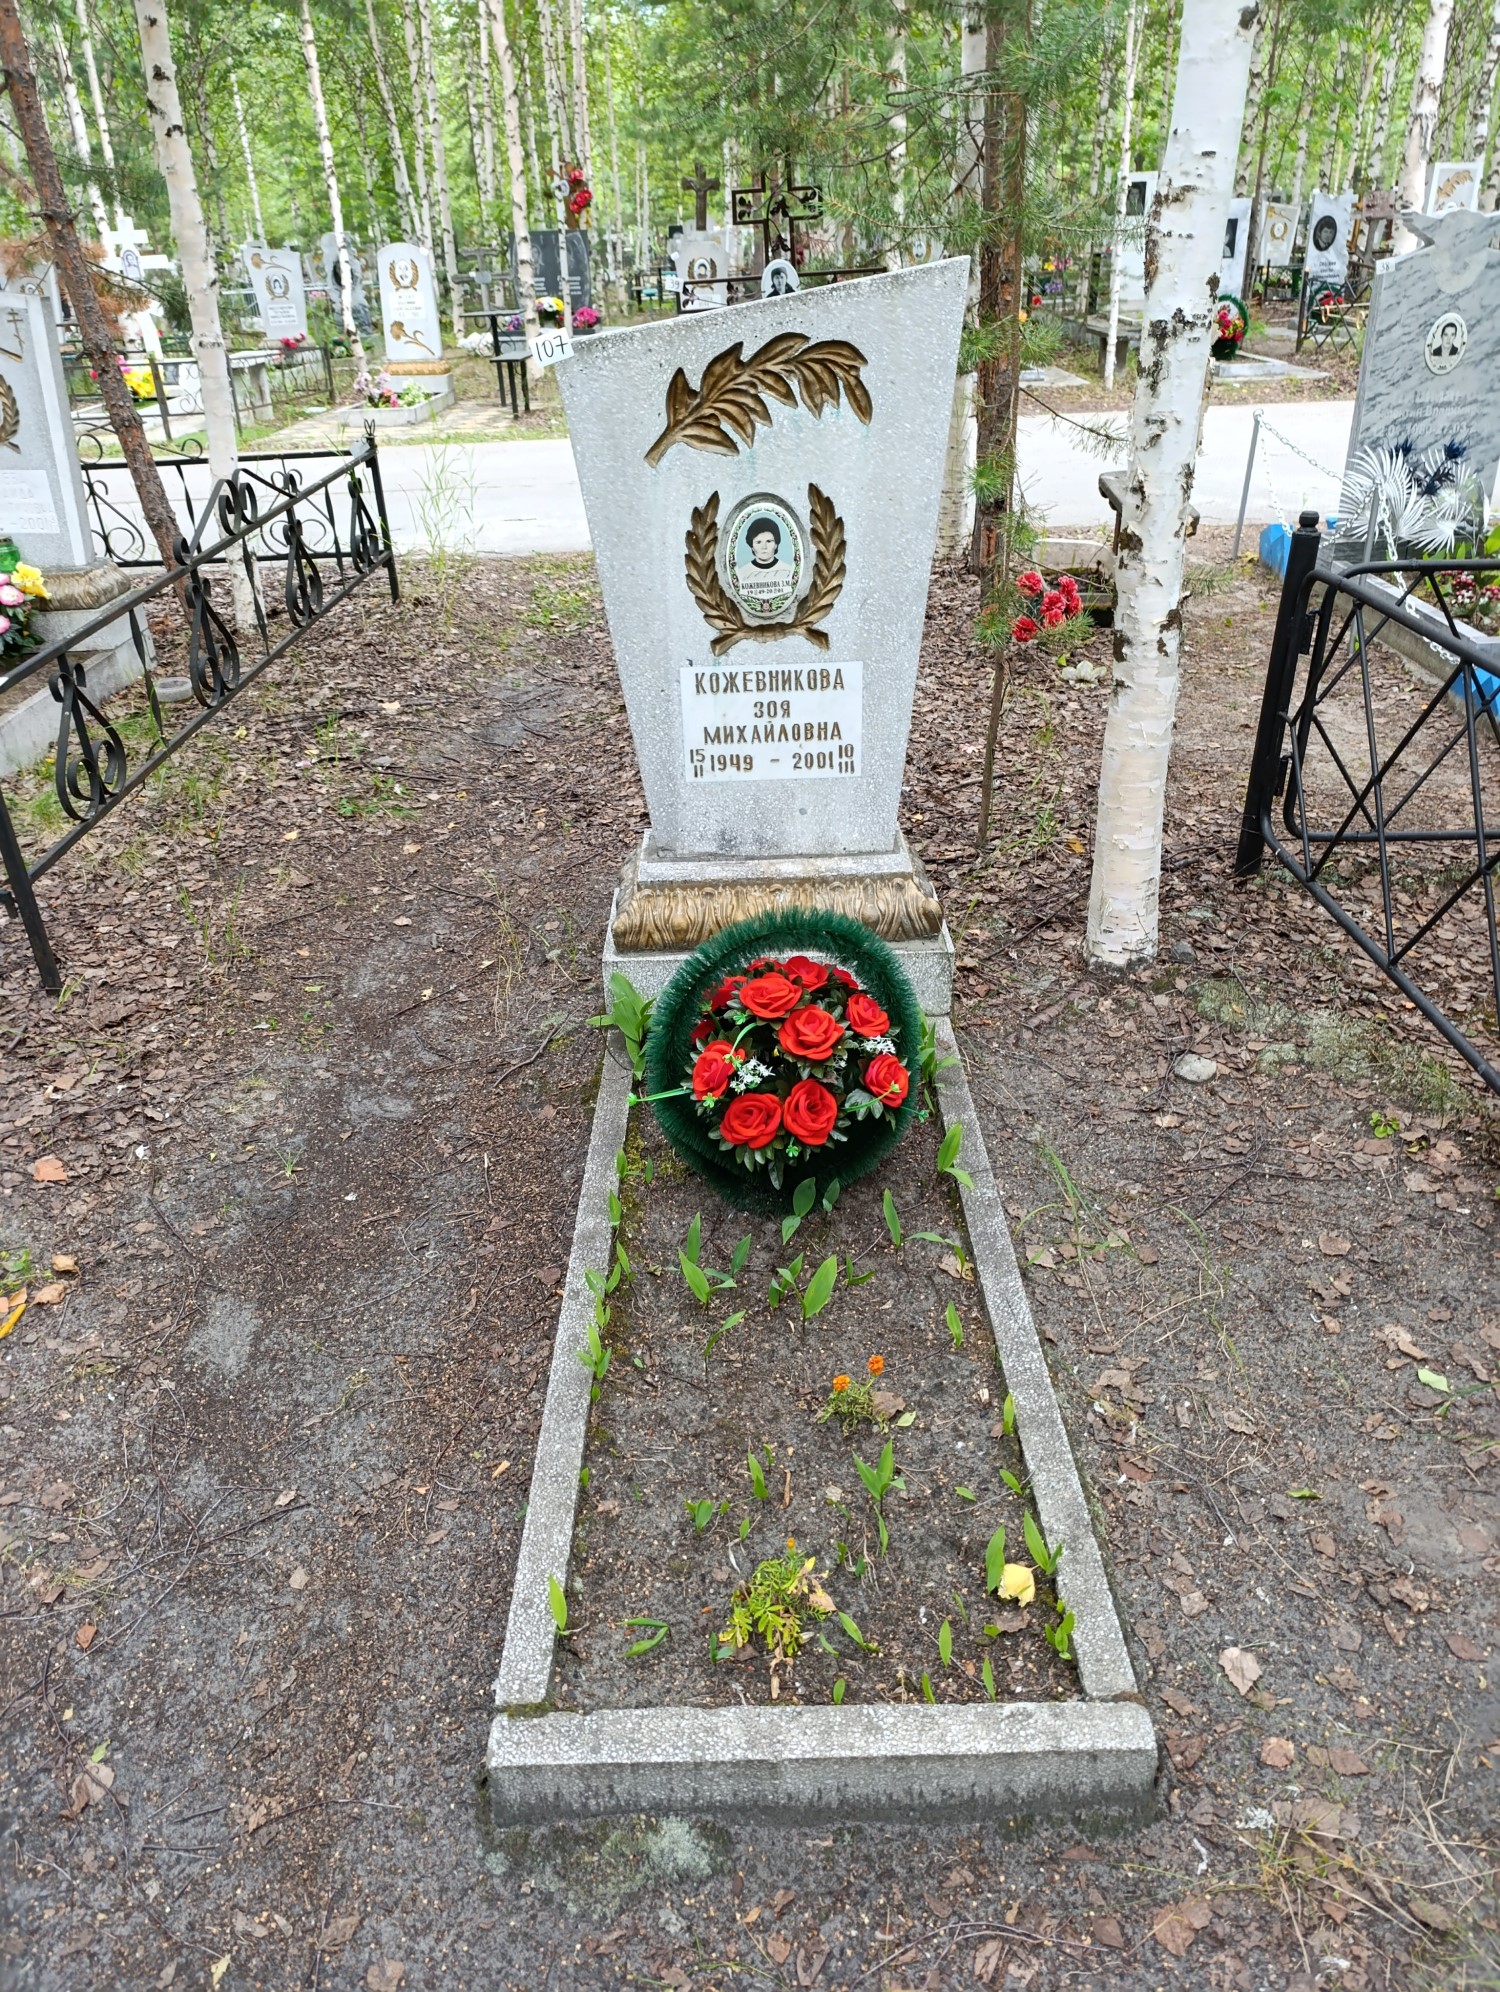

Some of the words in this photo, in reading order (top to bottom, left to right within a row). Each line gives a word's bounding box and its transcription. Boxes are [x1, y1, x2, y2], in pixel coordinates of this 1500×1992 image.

[535, 334, 569, 362] 107
[695, 668, 845, 695] КОЖЕВНИКОВА
[753, 700, 791, 719] ЗОЯ
[703, 721, 843, 745] МИХАЙЛОВНА
[710, 753, 754, 773] 1949
[792, 751, 834, 771] 2001
